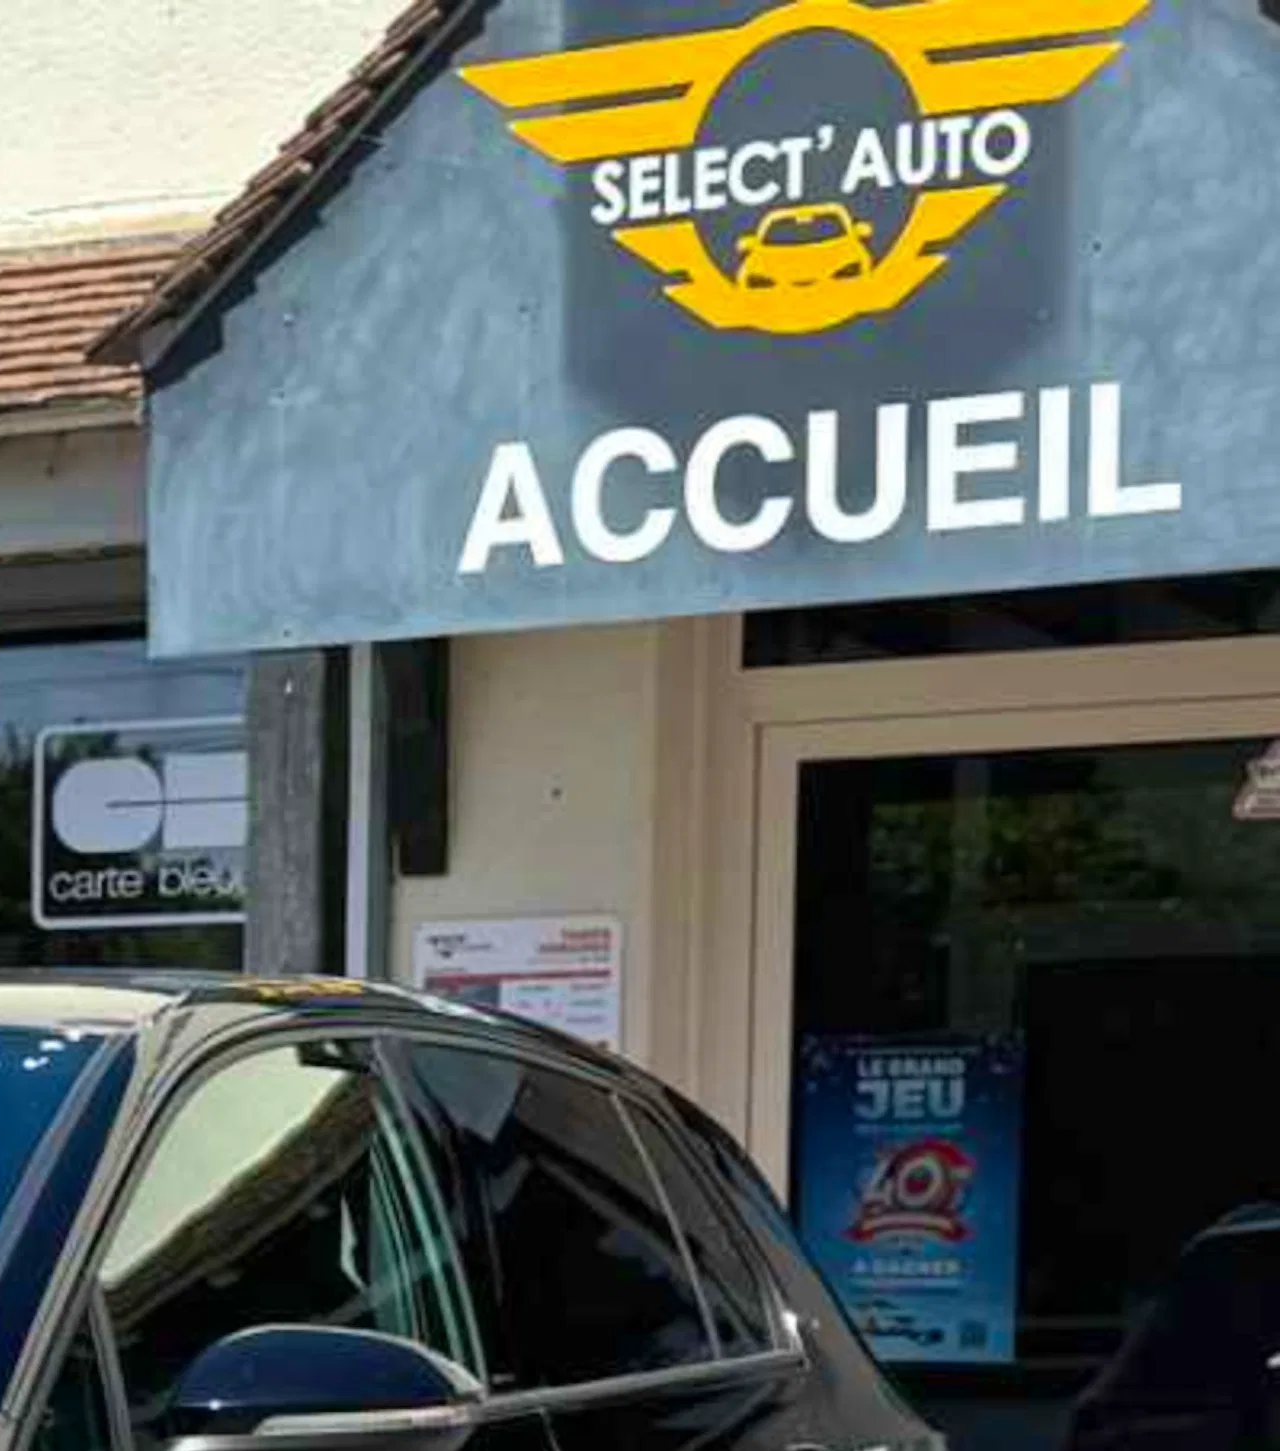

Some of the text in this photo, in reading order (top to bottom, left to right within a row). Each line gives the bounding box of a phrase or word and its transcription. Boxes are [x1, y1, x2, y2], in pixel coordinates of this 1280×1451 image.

[842, 110, 1032, 197] AUTO
[457, 381, 1182, 577] ACCUEIL
[49, 866, 144, 901] carte
[853, 1077, 967, 1120] JEU
